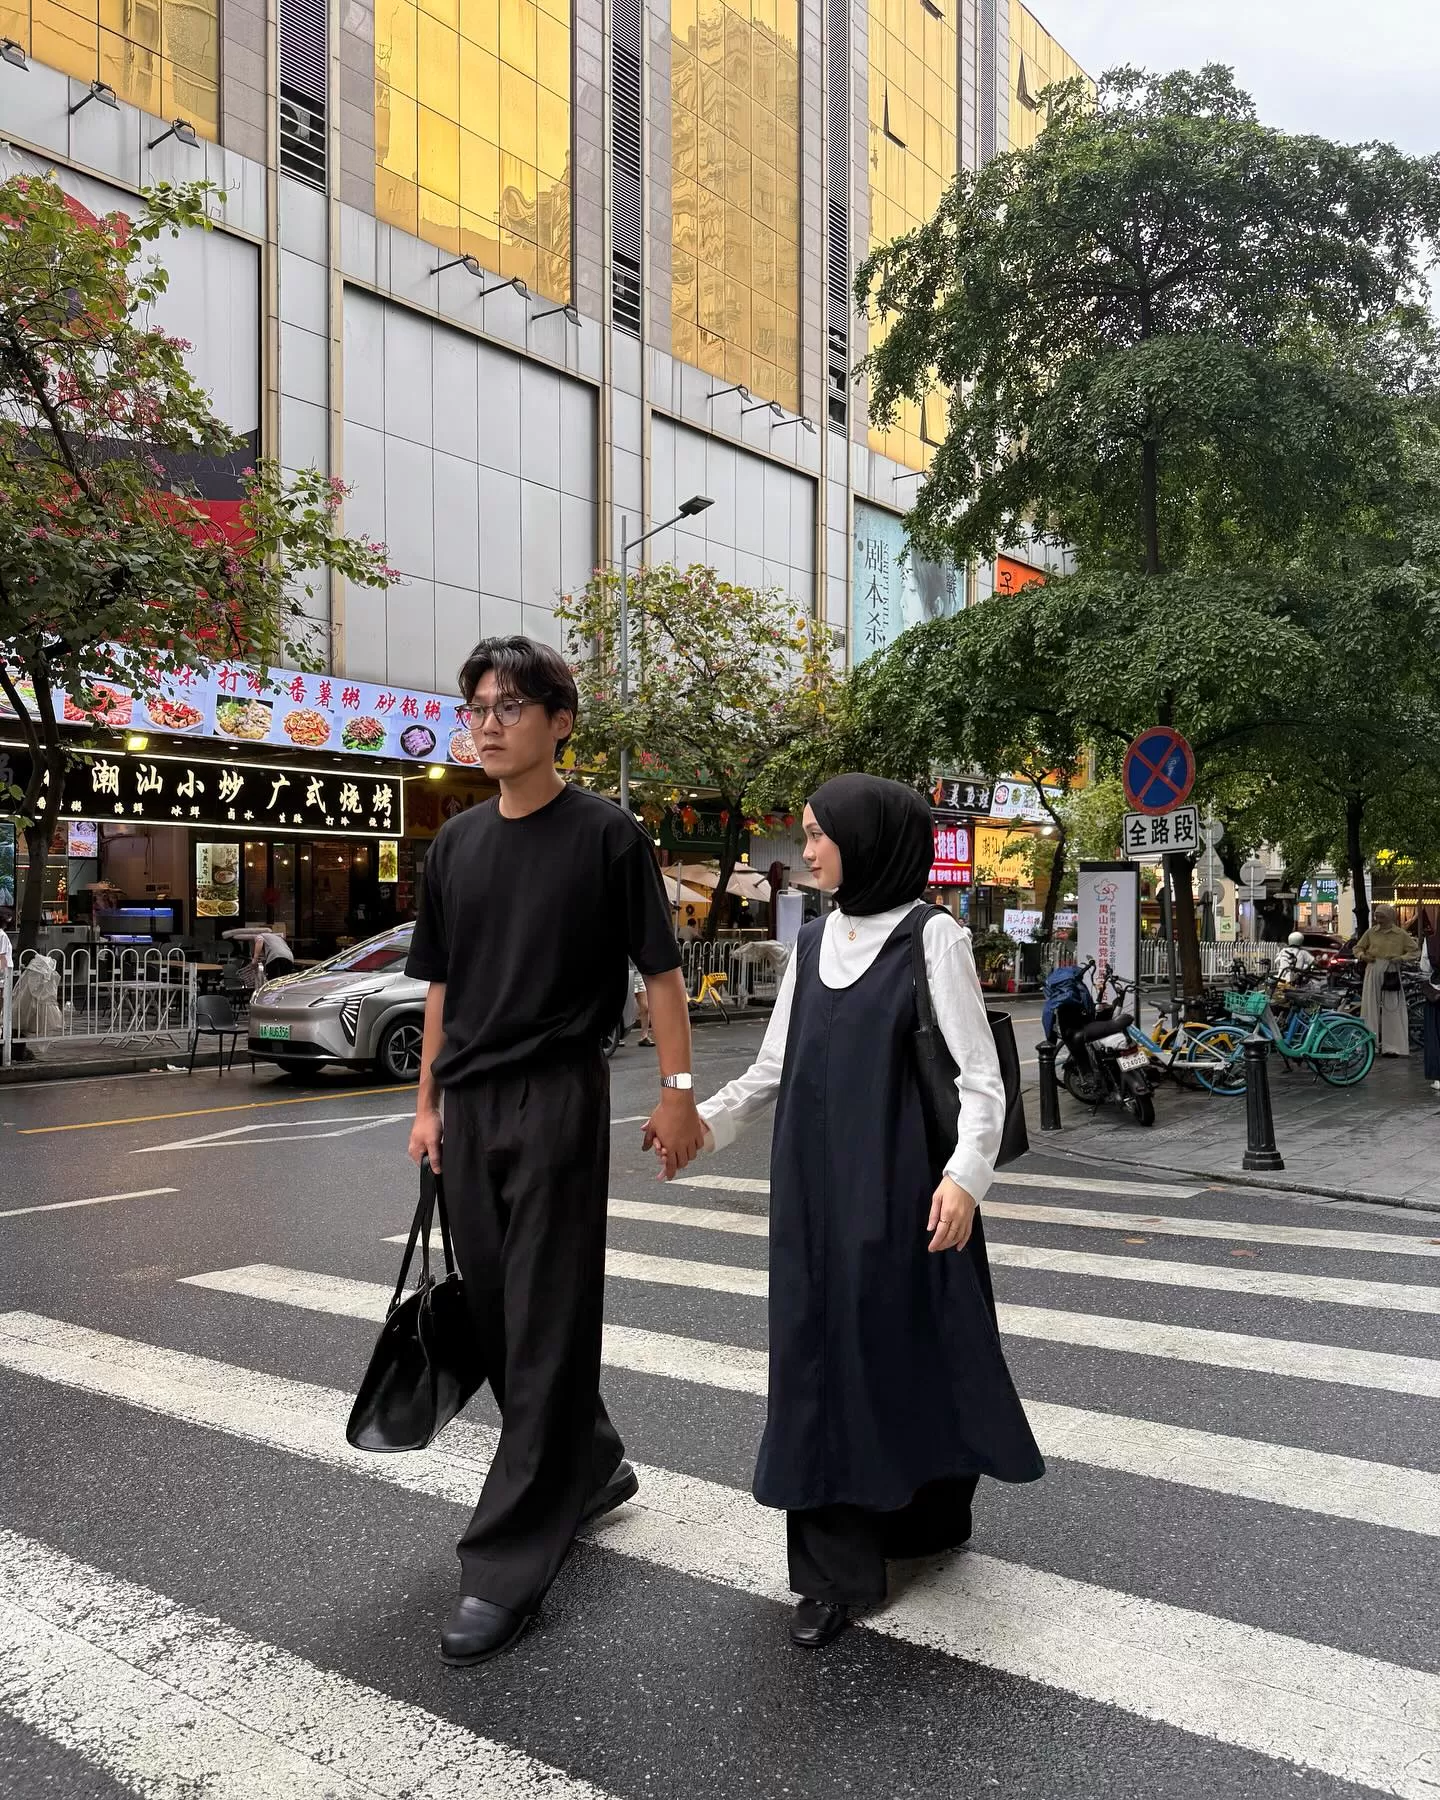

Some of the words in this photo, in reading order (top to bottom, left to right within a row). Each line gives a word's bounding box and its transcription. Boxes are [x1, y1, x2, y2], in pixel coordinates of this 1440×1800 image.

[865, 538, 883, 645] 剧本杀
[289, 676, 361, 711] 番薯粥
[375, 691, 441, 722] 砂锅粥
[36, 796, 82, 813] 番粥
[92, 759, 245, 803] 潮汕小炒
[266, 773, 393, 817] 广式烧烤
[1129, 814, 1194, 847] 全路段
